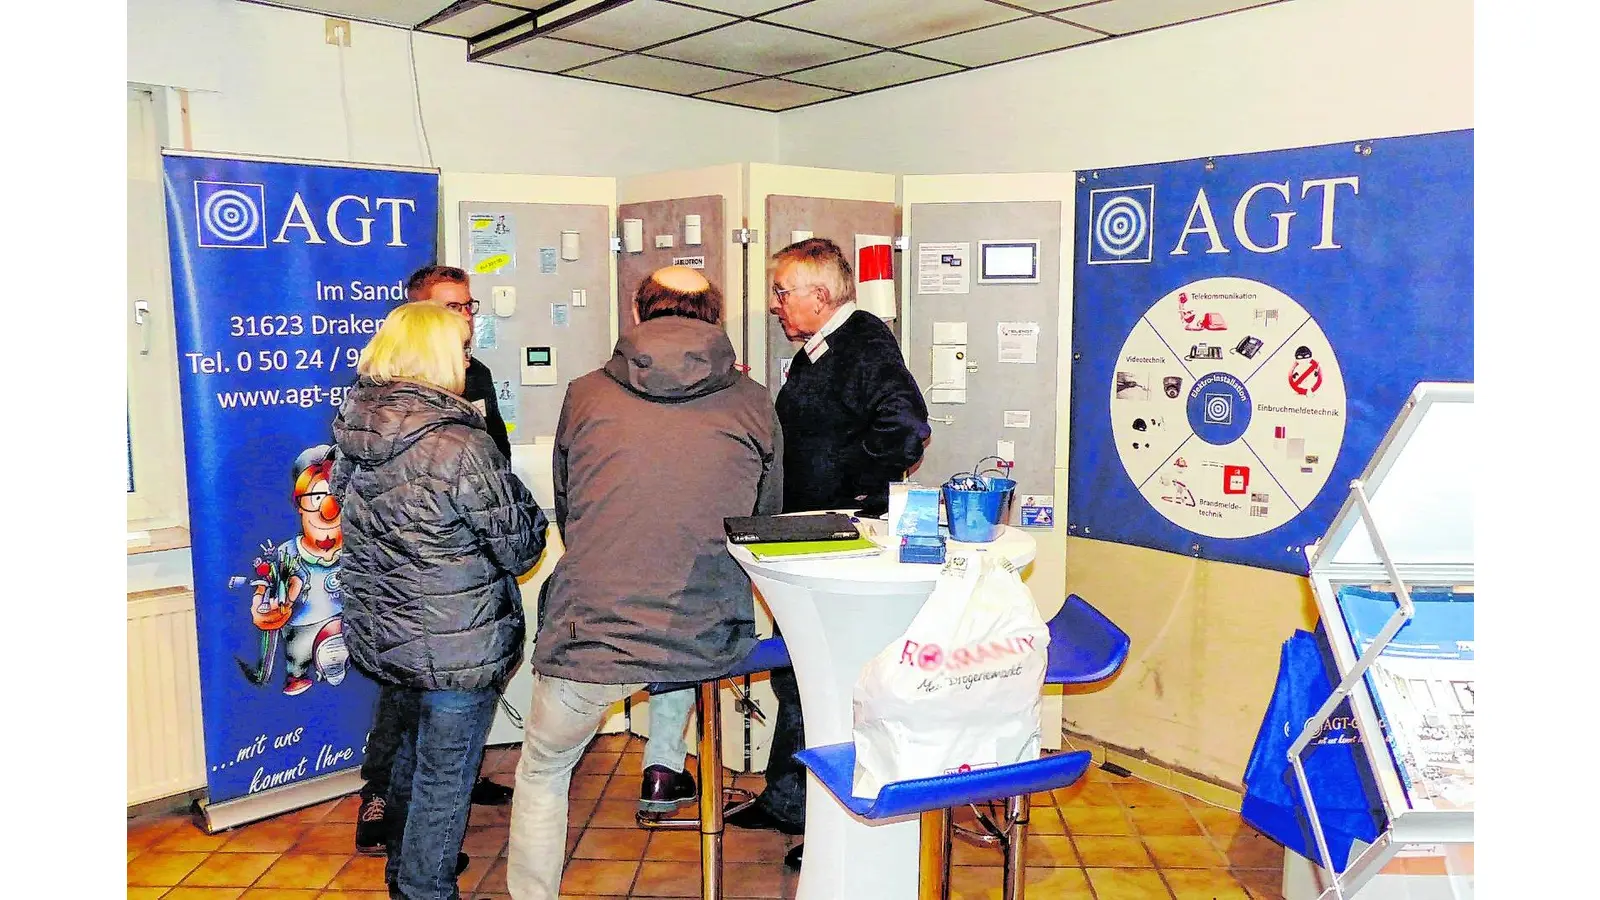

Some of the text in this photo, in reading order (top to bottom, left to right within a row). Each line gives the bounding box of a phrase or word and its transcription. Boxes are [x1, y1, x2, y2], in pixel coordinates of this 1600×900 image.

[272, 192, 416, 247] AGT
[1169, 175, 1359, 255] AGT
[316, 281, 344, 301] Im
[1191, 292, 1257, 301] Telekommunikation
[230, 315, 304, 337] 31623
[185, 346, 362, 374] Tel. 0 50 24 / 9
[1125, 355, 1166, 364] Videotechnik
[216, 385, 352, 409] www.agt-gr
[1190, 374, 1247, 402] Elektro-Installation
[1257, 403, 1339, 417] Einbruchmeldetechnik
[1198, 509, 1223, 519] technik
[1199, 498, 1242, 510] Brandmelde-
[274, 726, 304, 749] uns
[248, 744, 354, 794] kommt Ihre
